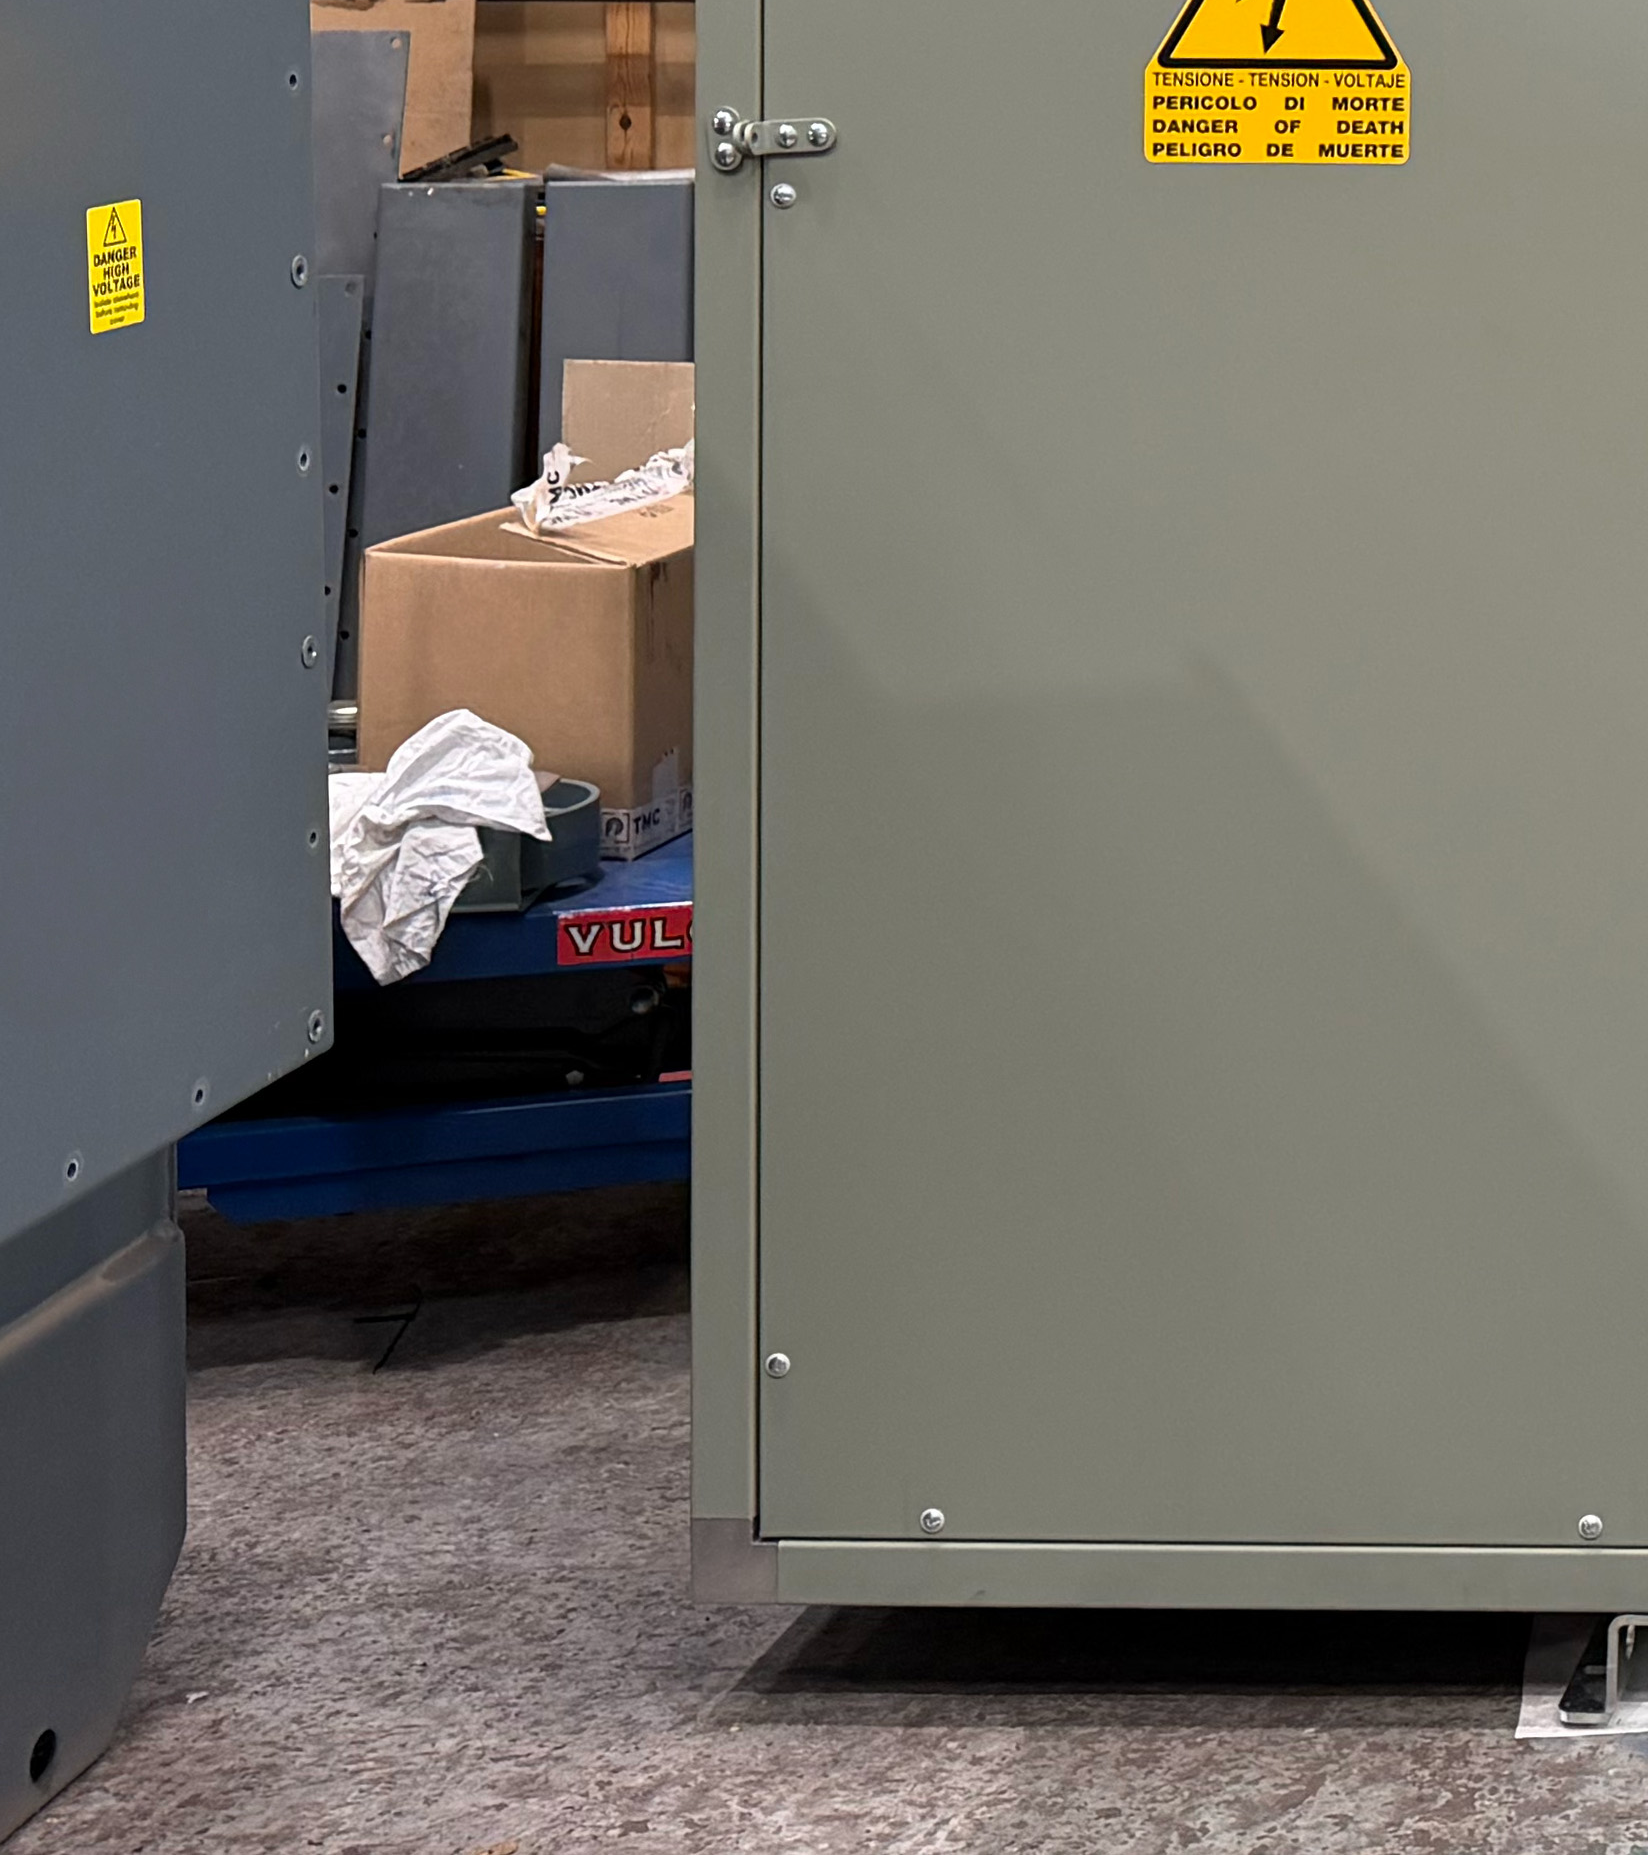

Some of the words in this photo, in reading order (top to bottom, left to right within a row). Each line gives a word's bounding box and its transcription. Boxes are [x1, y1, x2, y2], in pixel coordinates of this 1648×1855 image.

[1153, 72, 1234, 86] TENSIONE
[1250, 72, 1319, 87] TENSION
[1333, 73, 1405, 88] VOLTAJE
[1153, 96, 1257, 110] PERICOLO
[1285, 97, 1304, 110] DI
[1332, 97, 1405, 111] MORTE
[1153, 119, 1238, 133] DANGER
[1274, 120, 1301, 133] OF
[1337, 121, 1404, 134] DEATH
[1153, 143, 1242, 157] PELIGRO
[1267, 143, 1294, 157] DE
[1319, 143, 1404, 158] MUERTE
[93, 246, 137, 267] DANGER
[103, 262, 129, 280] HIGH
[93, 275, 140, 297] VOLTAGE
[565, 918, 693, 957] VUL
